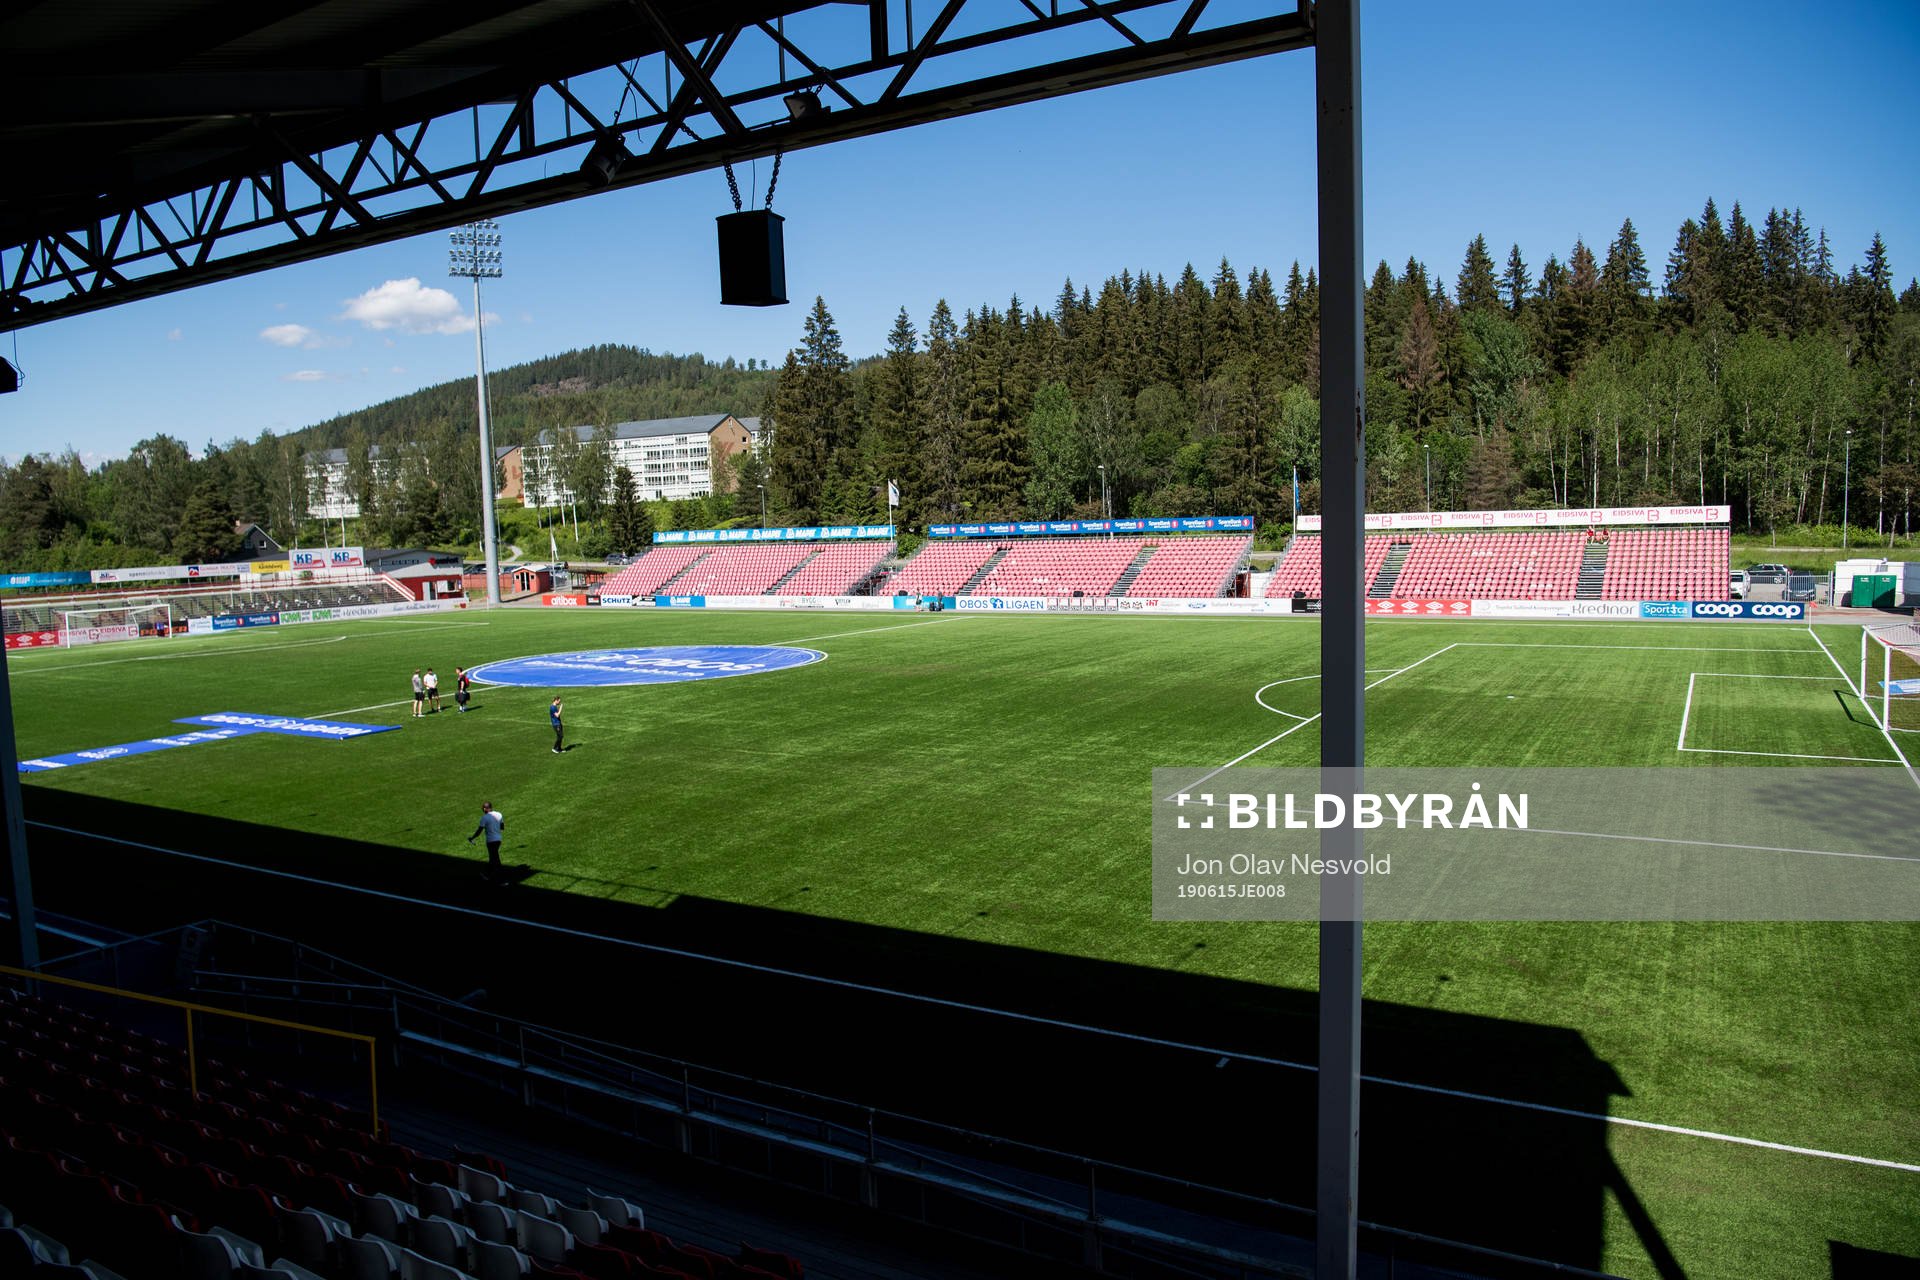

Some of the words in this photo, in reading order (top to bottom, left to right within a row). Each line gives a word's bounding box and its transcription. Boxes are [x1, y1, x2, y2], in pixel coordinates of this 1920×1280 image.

[960, 600, 988, 608] OBOS
[1006, 600, 1044, 609] LIGAEN
[1695, 603, 1743, 617] coop
[1751, 604, 1801, 618] coop
